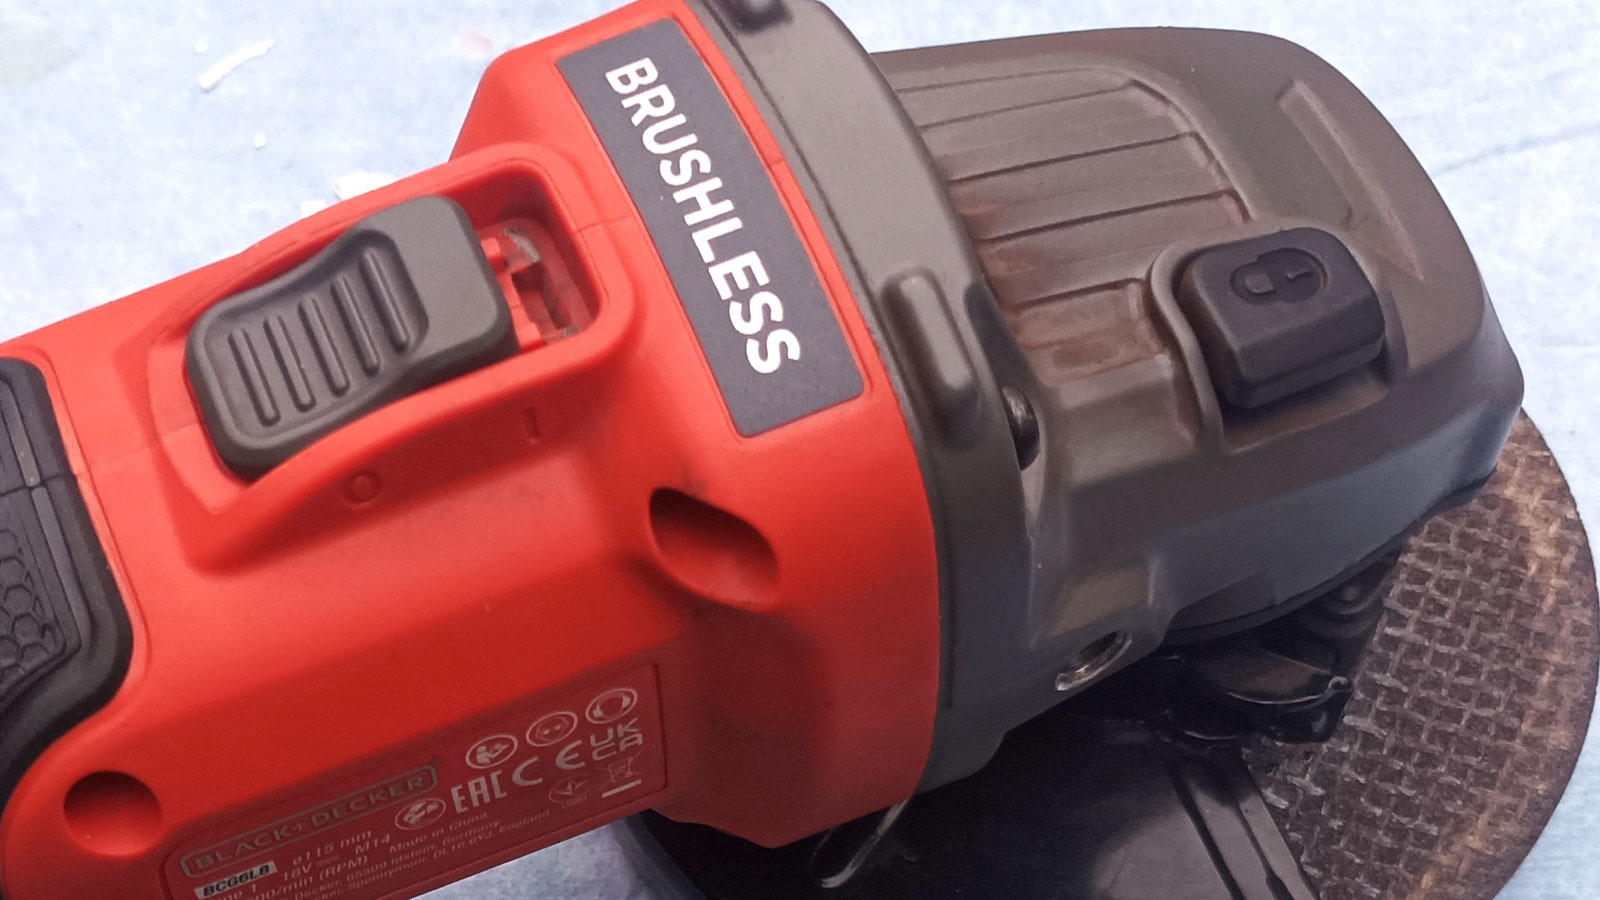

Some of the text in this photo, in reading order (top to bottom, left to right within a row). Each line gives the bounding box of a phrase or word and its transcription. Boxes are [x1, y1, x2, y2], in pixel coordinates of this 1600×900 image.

[604, 57, 801, 374] BRUSHLESS
[194, 775, 426, 869] BLACK+DECKER
[355, 833, 390, 855] M14
[389, 835, 428, 854] Made
[449, 812, 488, 831] China
